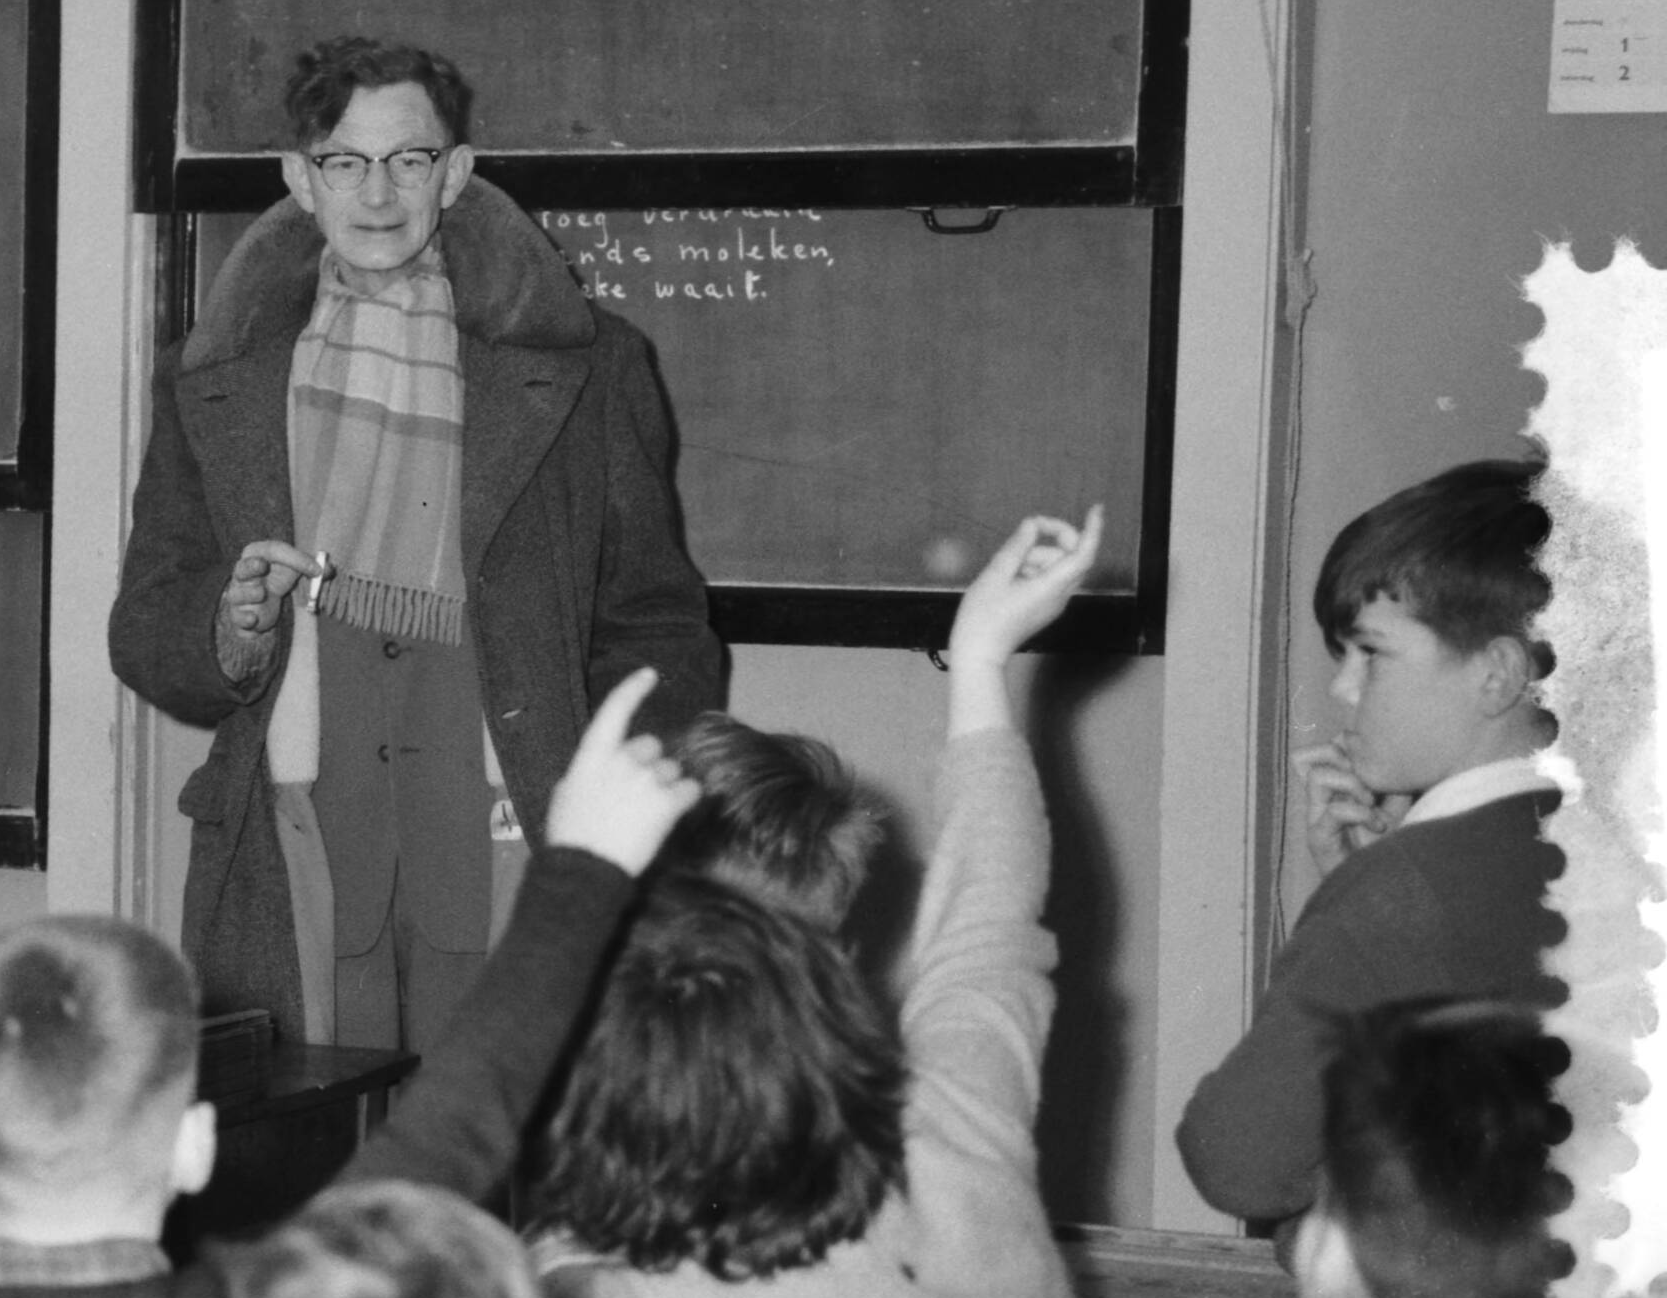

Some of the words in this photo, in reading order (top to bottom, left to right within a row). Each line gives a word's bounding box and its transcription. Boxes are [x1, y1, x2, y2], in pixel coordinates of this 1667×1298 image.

[1620, 38, 1630, 53] 1
[1618, 65, 1630, 81] 2
[541, 210, 609, 249] roeg
[560, 238, 652, 265] nds
[679, 227, 835, 267] moleken,
[655, 270, 768, 300] waait.
